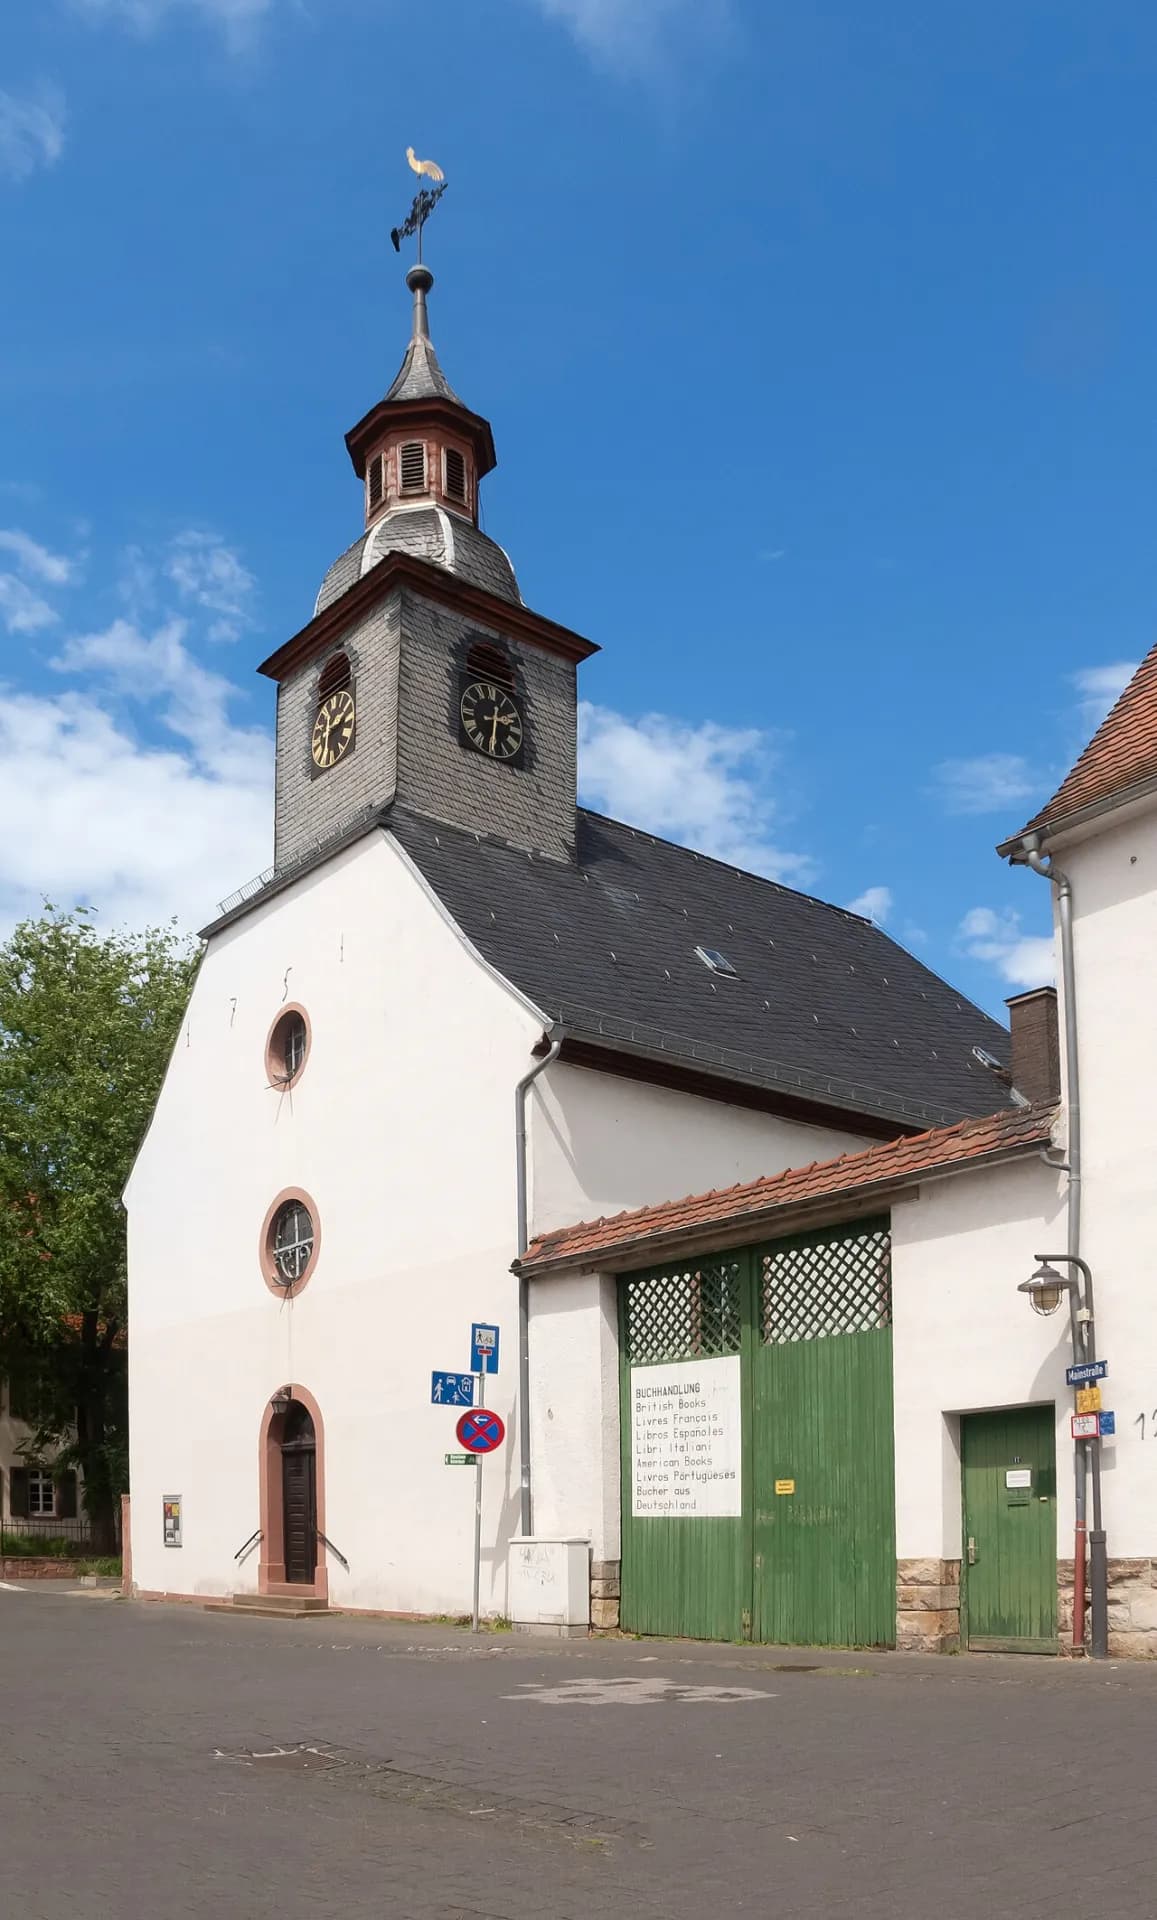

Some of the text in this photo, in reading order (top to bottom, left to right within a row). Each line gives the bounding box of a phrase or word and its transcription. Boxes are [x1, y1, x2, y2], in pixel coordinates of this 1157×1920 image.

[636, 1382, 701, 1399] BUCHHANDLUNG
[636, 1398, 706, 1413] British Books
[636, 1413, 718, 1427] Livres Français
[1134, 1409, 1157, 1441] 1
[636, 1424, 724, 1441] Libros Españoles
[636, 1441, 711, 1455] Libri Italiani
[637, 1455, 713, 1468] American Books
[636, 1471, 669, 1482] Livros
[674, 1487, 690, 1496] aus
[636, 1499, 697, 1510] Deutschland
